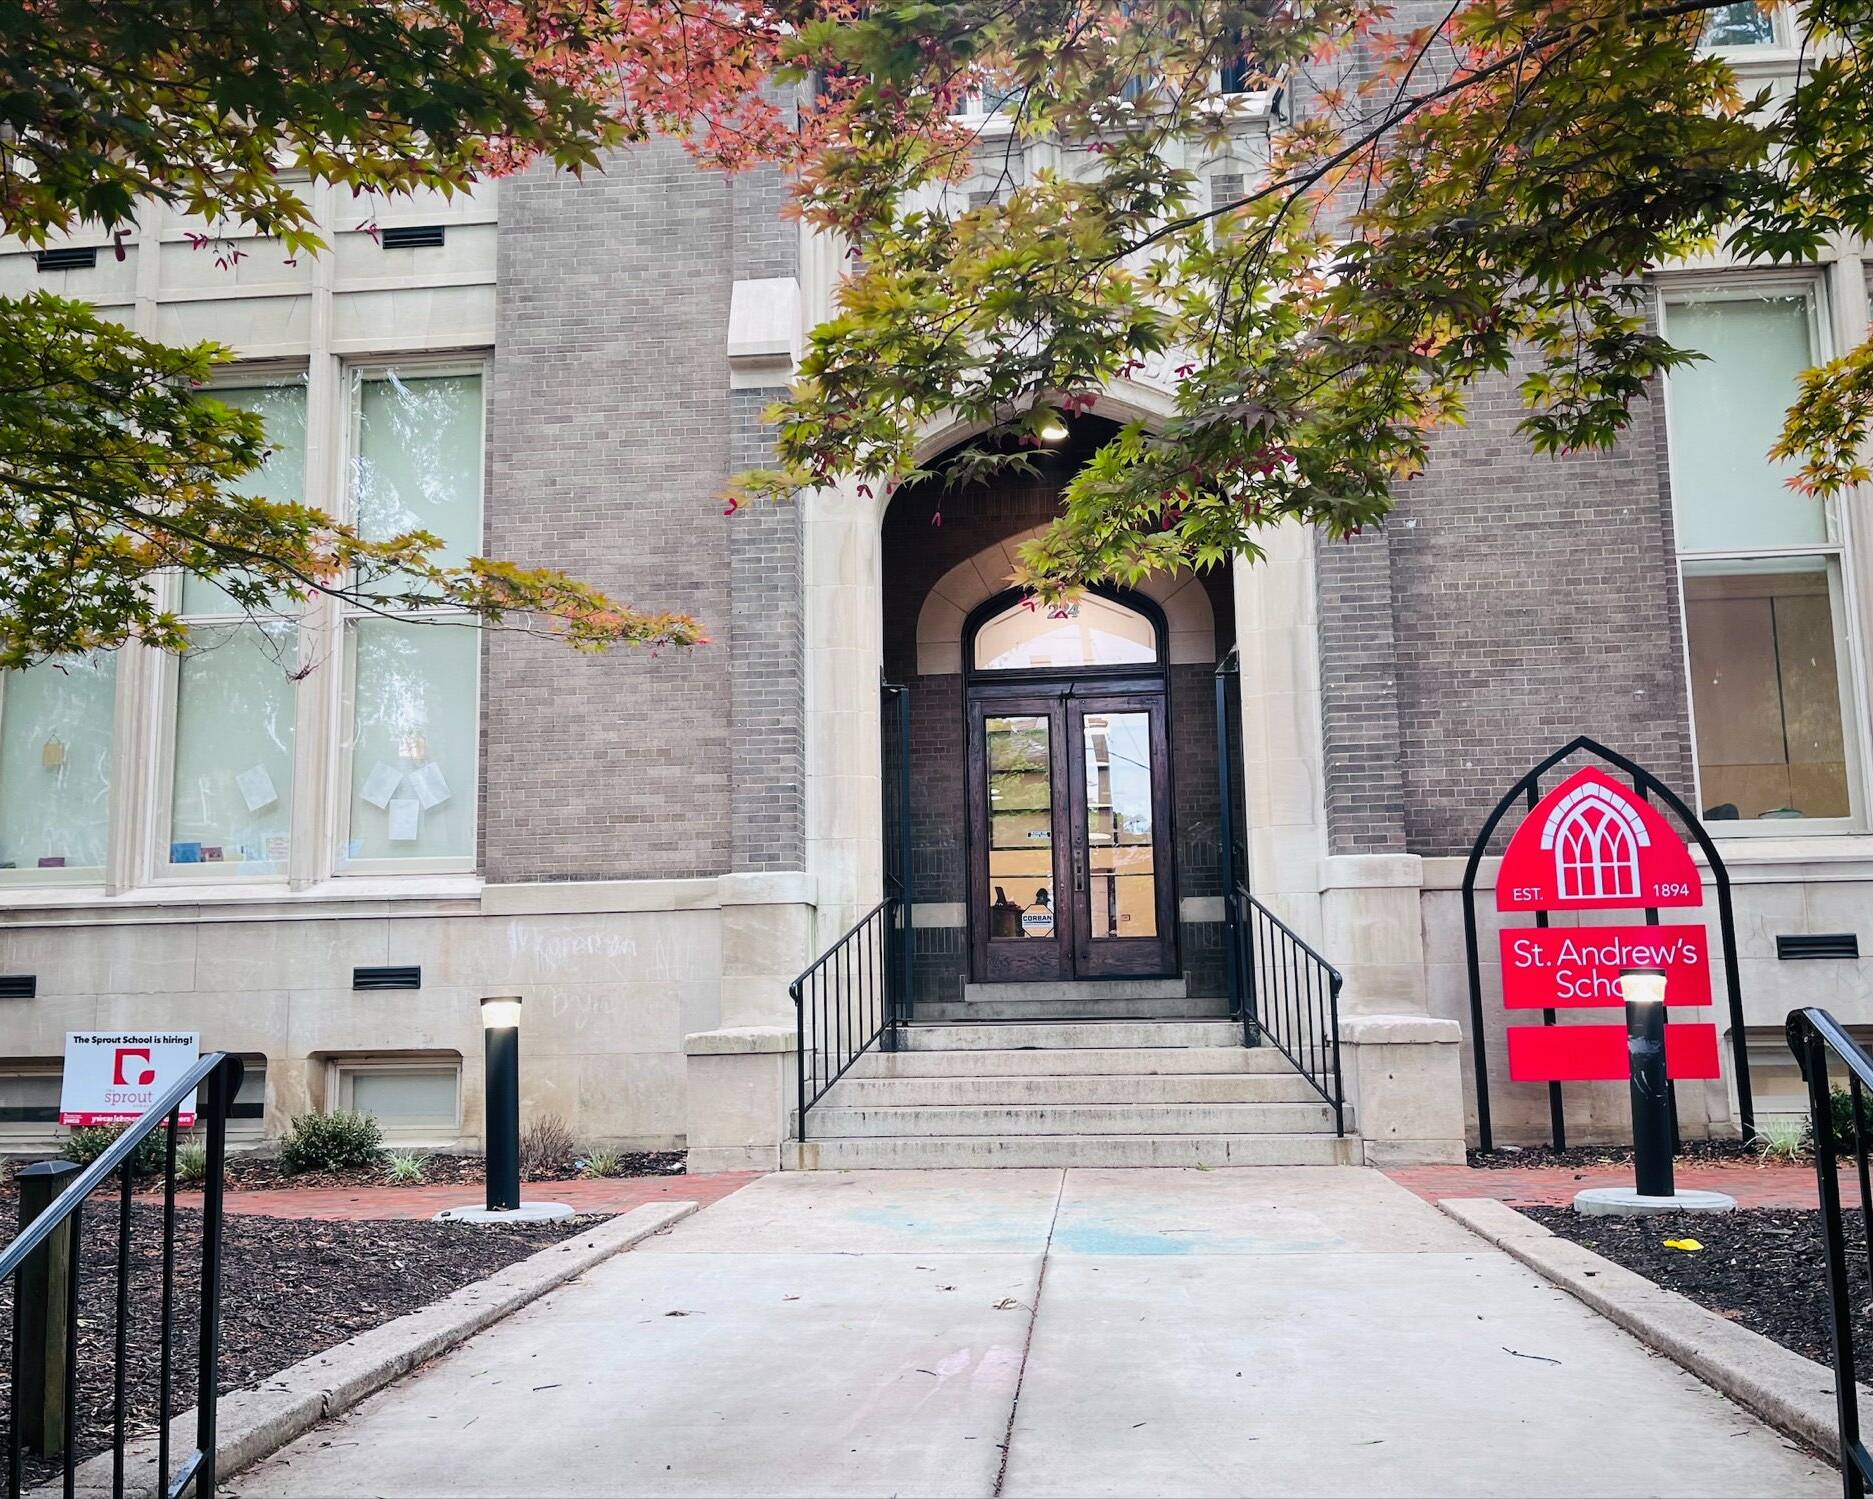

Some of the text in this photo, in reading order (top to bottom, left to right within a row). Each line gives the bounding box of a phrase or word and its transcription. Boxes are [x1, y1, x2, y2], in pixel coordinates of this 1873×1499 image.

[1512, 887, 1544, 901] EST.
[1652, 883, 1690, 898] 1894
[1512, 936, 1698, 968] St. Andrew's
[1556, 969, 1624, 998] Scho
[73, 1035, 193, 1046] The Sprout School is hiring!
[104, 1090, 153, 1106] sprout
